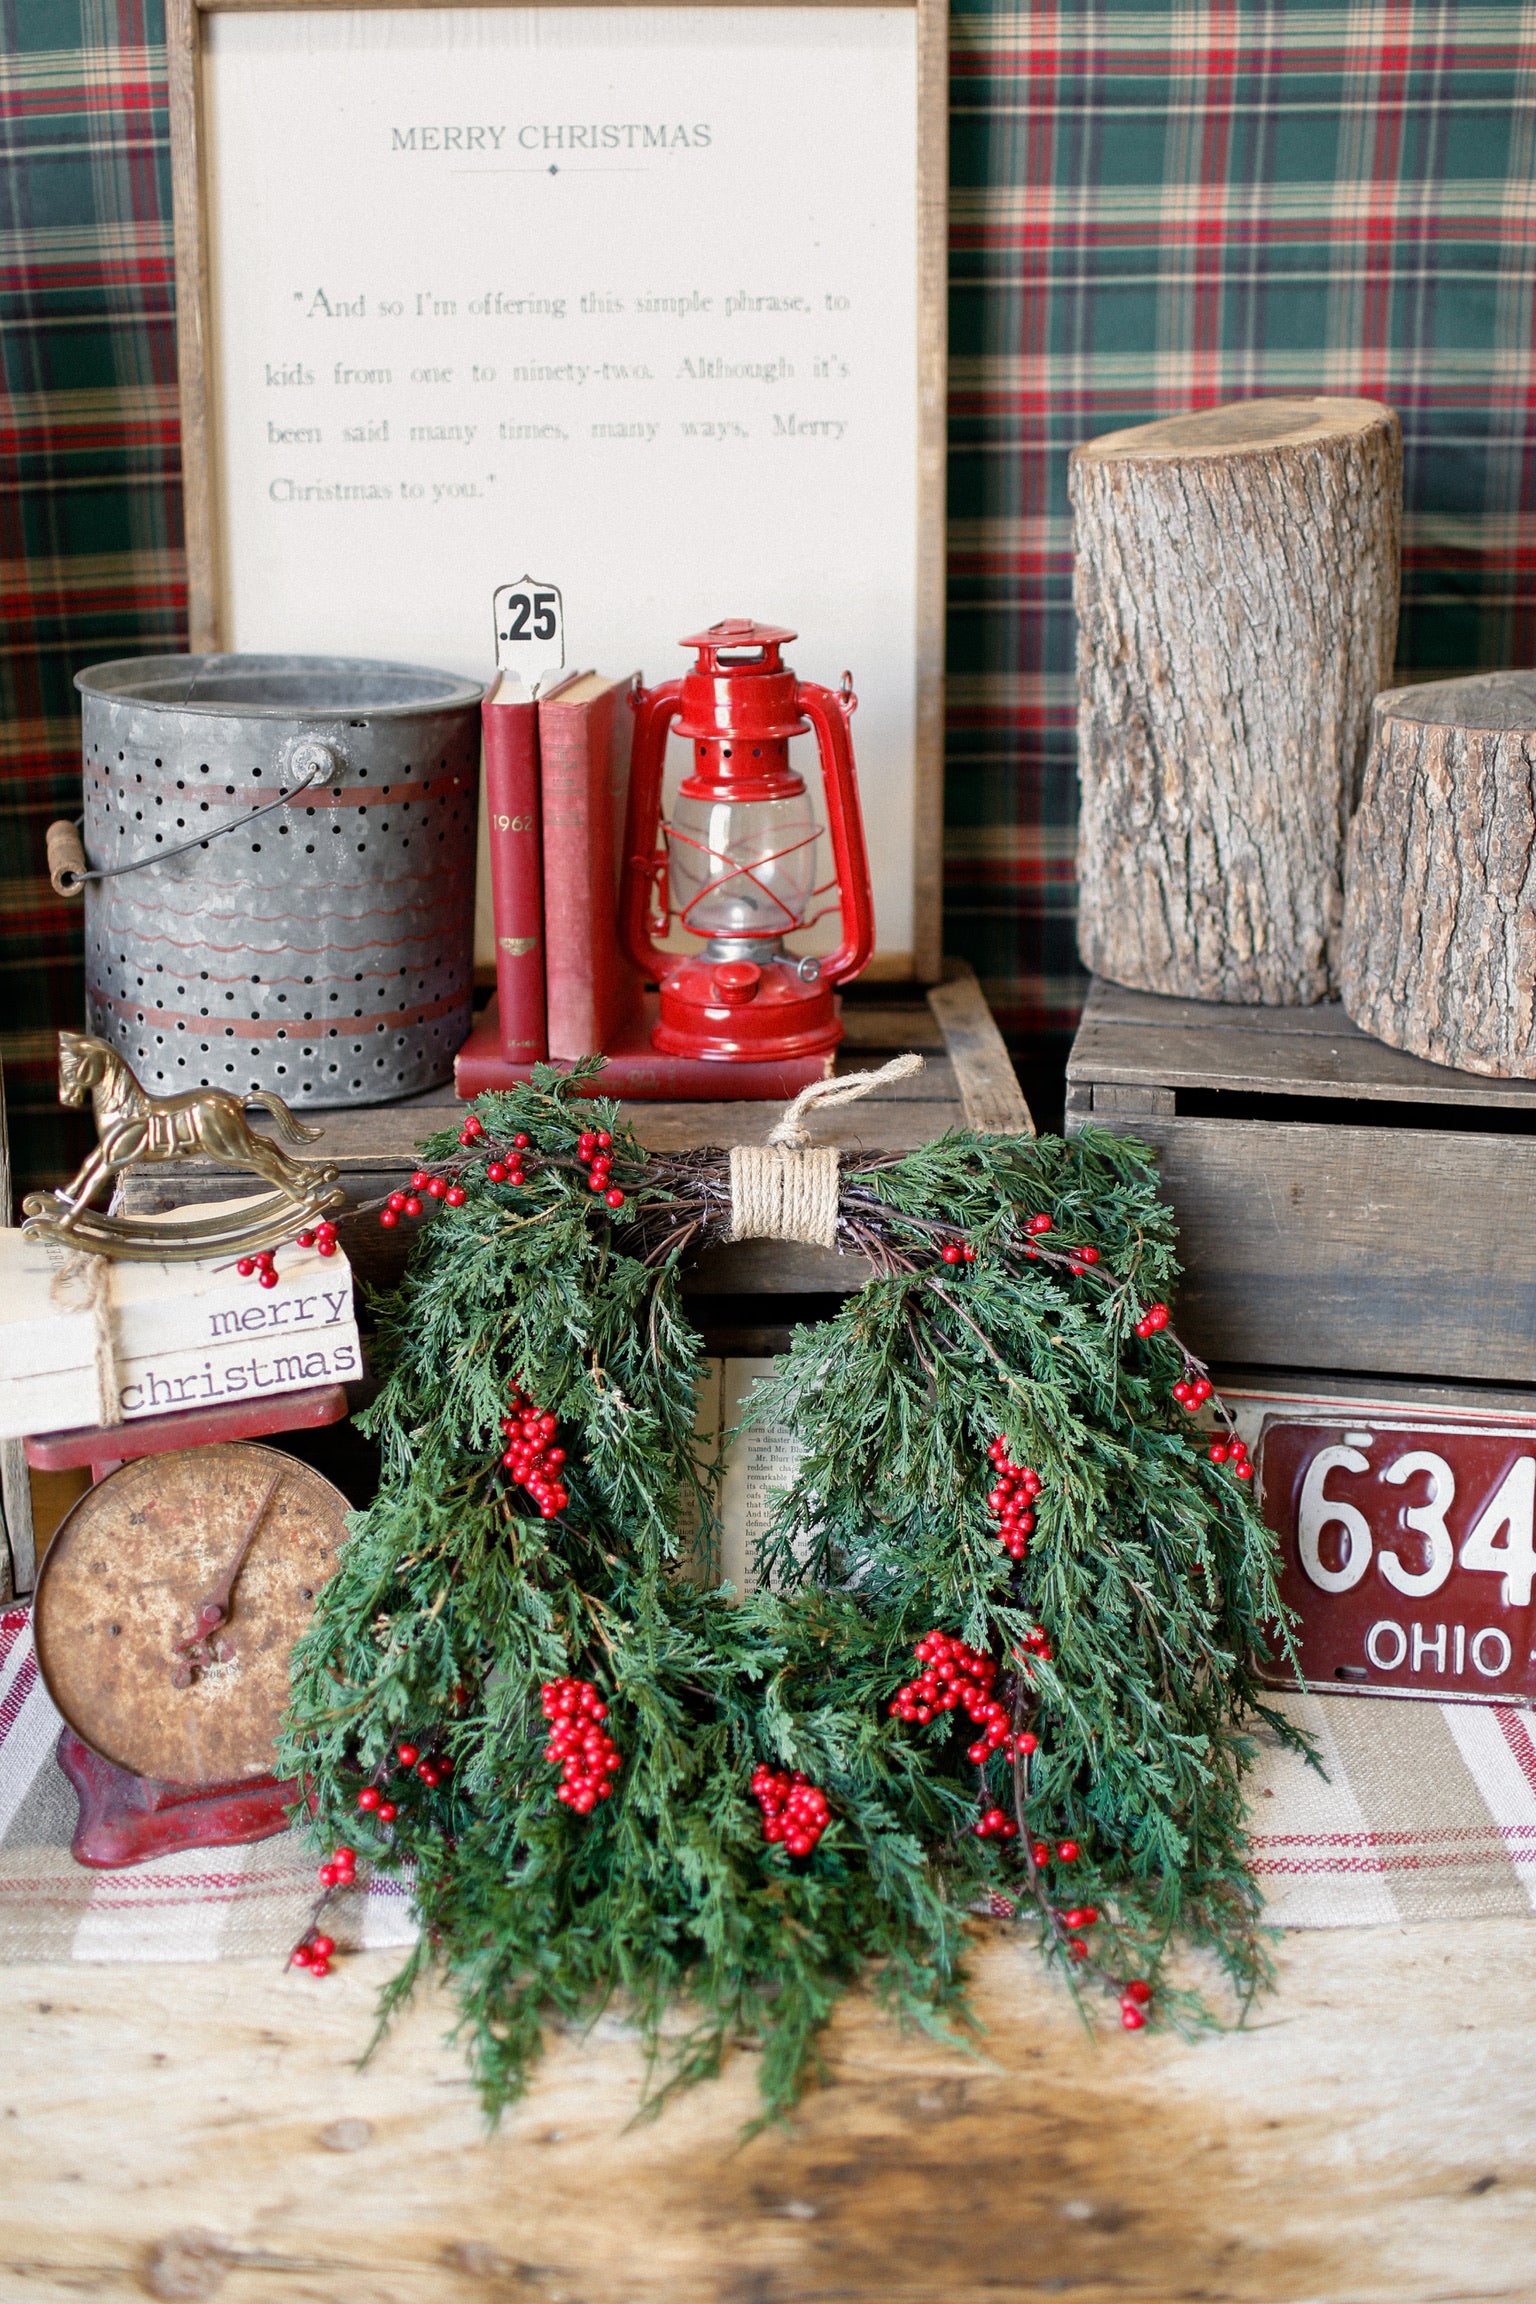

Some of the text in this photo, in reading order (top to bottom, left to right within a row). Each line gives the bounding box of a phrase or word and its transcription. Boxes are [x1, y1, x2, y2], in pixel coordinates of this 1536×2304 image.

[391, 123, 713, 152] MERRY CHRISTMAS
[378, 301, 405, 317] so
[416, 291, 457, 317] I'm
[467, 291, 567, 320] offering
[579, 291, 625, 314] this
[636, 289, 713, 319] simple
[724, 289, 812, 318] phrase,
[824, 293, 851, 312] to
[264, 361, 316, 387] kids
[333, 361, 393, 385] from
[410, 367, 454, 384] one
[471, 364, 497, 383] to
[676, 356, 795, 384] Although
[813, 354, 849, 378] it's
[266, 420, 323, 444] been
[343, 419, 390, 443] said
[409, 425, 478, 446] many
[498, 418, 569, 441] times,
[591, 422, 659, 443] many
[772, 413, 848, 441] Merry
[268, 478, 393, 502] Christmas
[400, 482, 425, 500] to
[499, 593, 556, 641] .25
[493, 815, 533, 832] 1962
[209, 1289, 348, 1337] merry
[119, 1345, 356, 1412] christmas
[747, 1464, 773, 1472] reddest
[747, 1473, 787, 1481] remarkable
[1298, 1444, 1536, 1607] 634
[1366, 1620, 1512, 1677] OHIO
